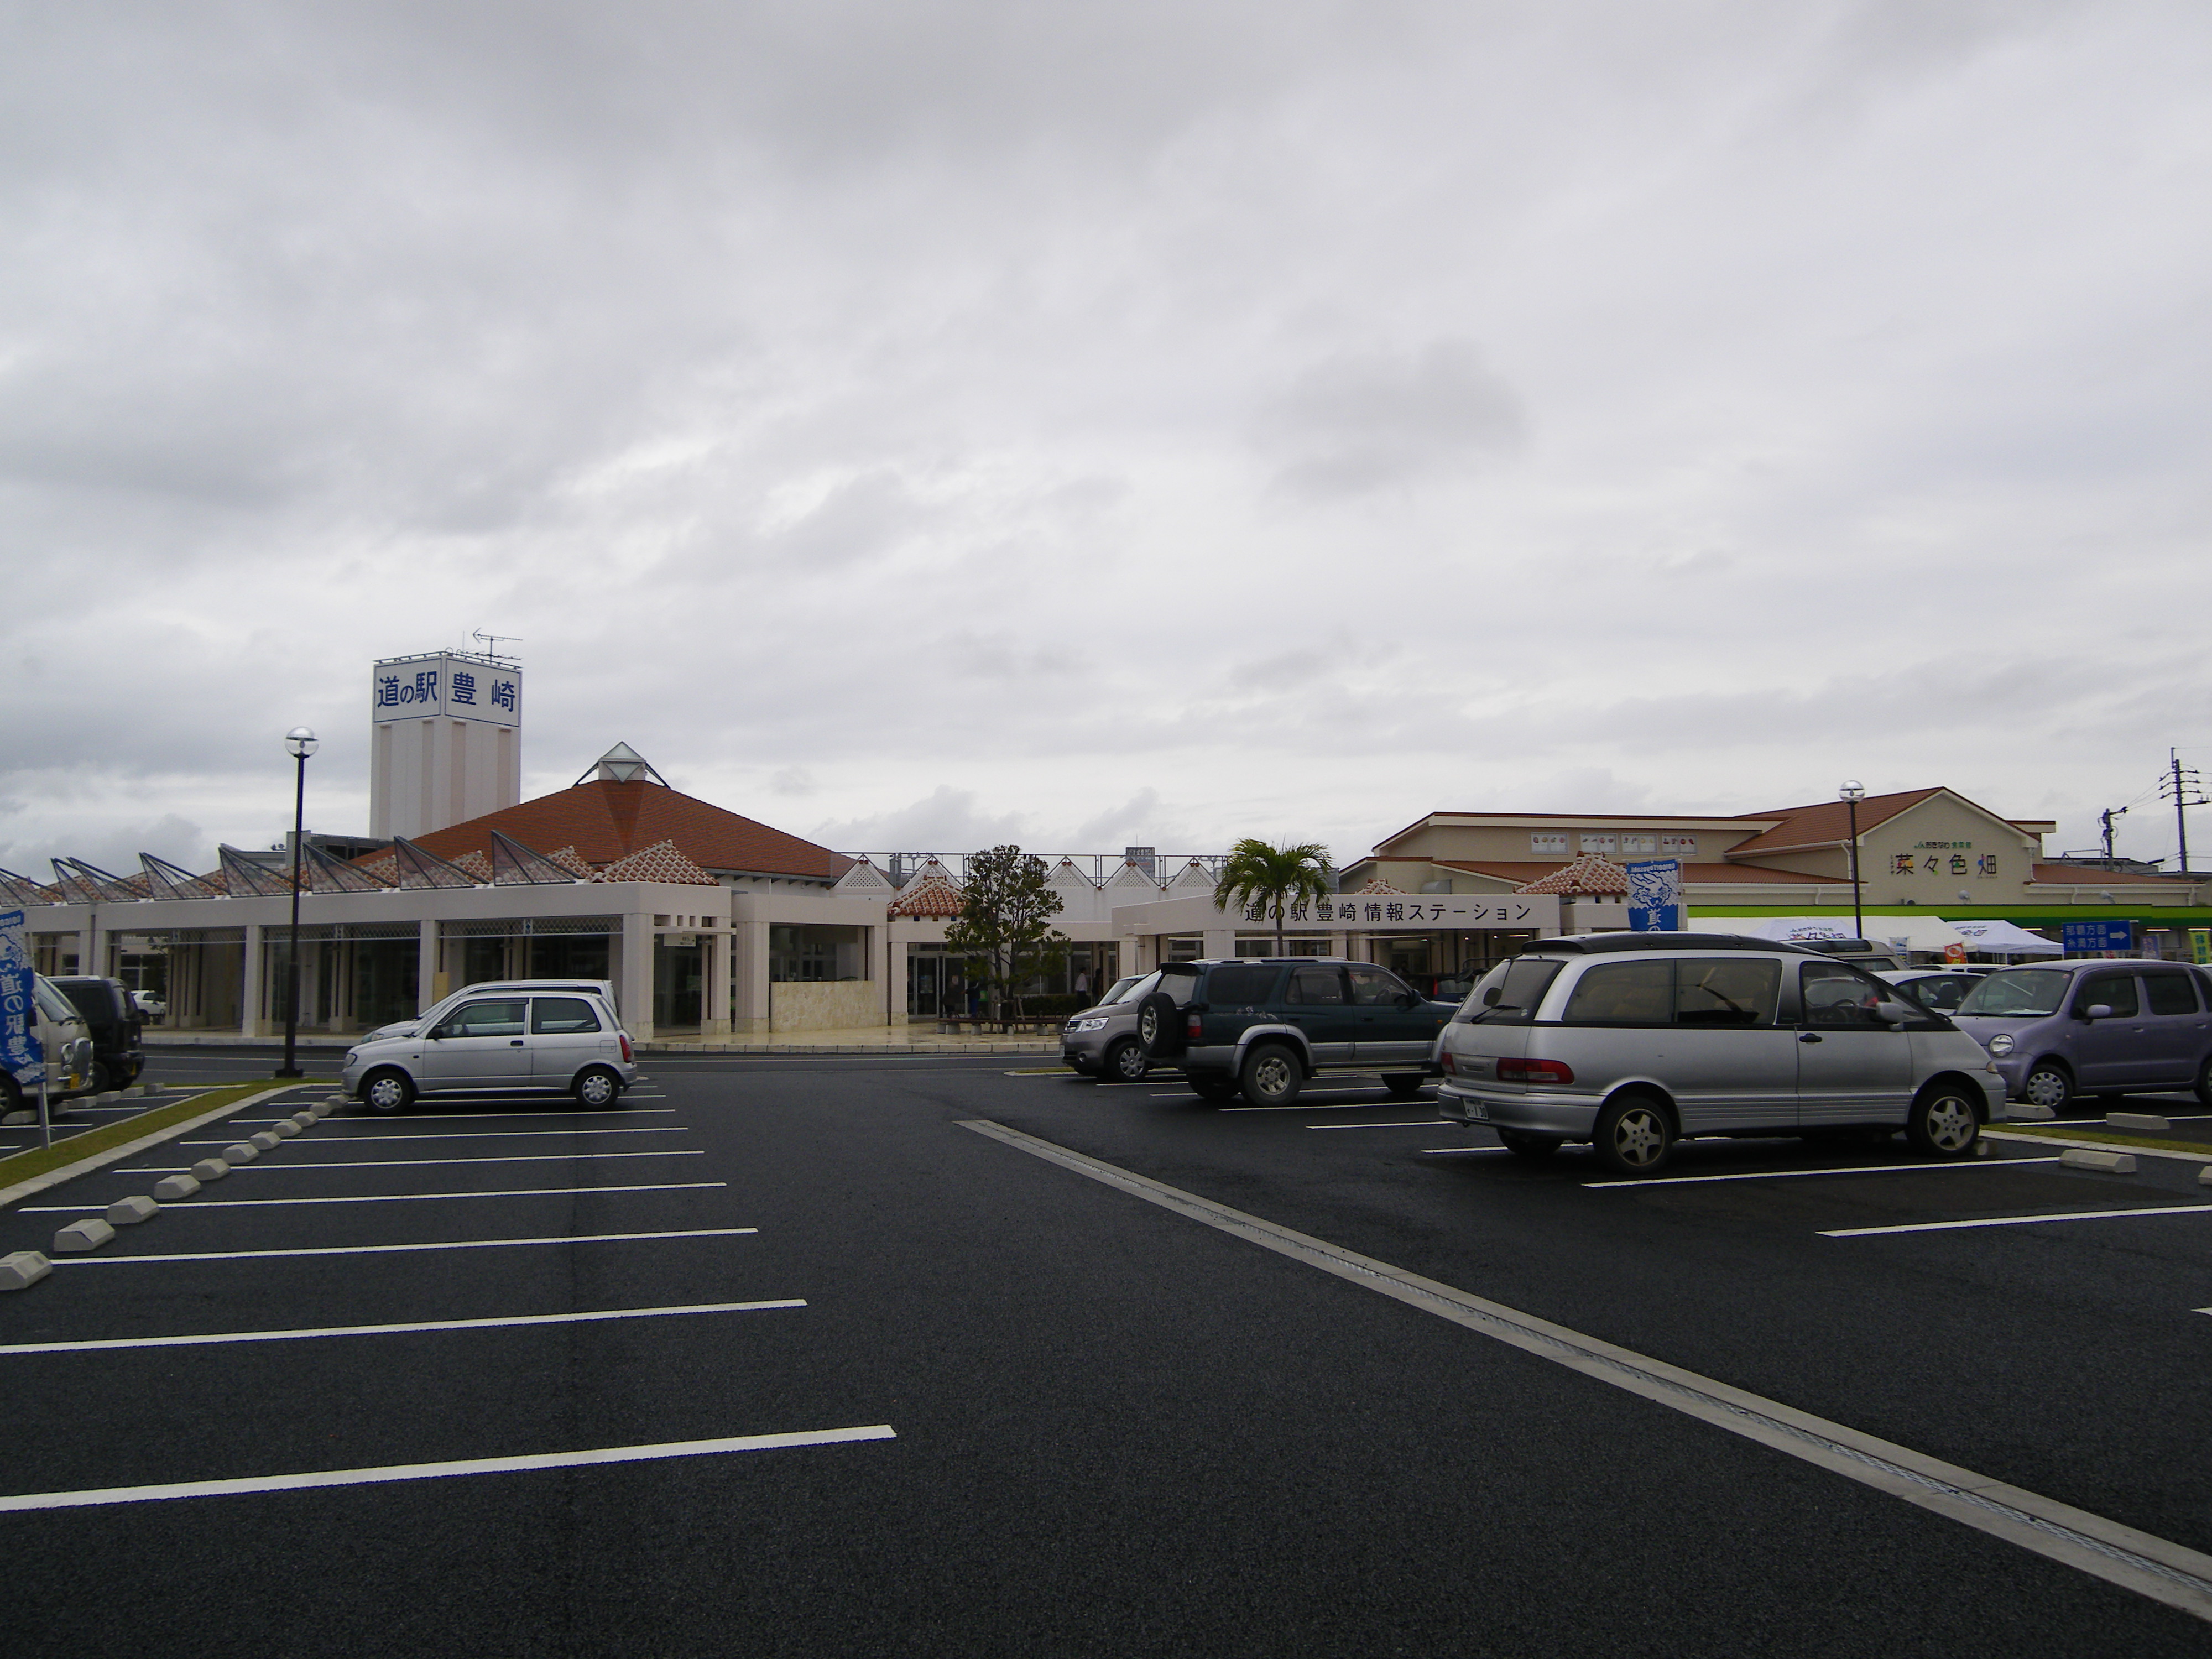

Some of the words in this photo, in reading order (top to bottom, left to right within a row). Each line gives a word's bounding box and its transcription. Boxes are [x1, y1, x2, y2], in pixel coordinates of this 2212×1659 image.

[378, 671, 437, 708] 道の駅
[451, 672, 515, 712] 豊崎
[1895, 853, 1997, 875] 菜々色畑
